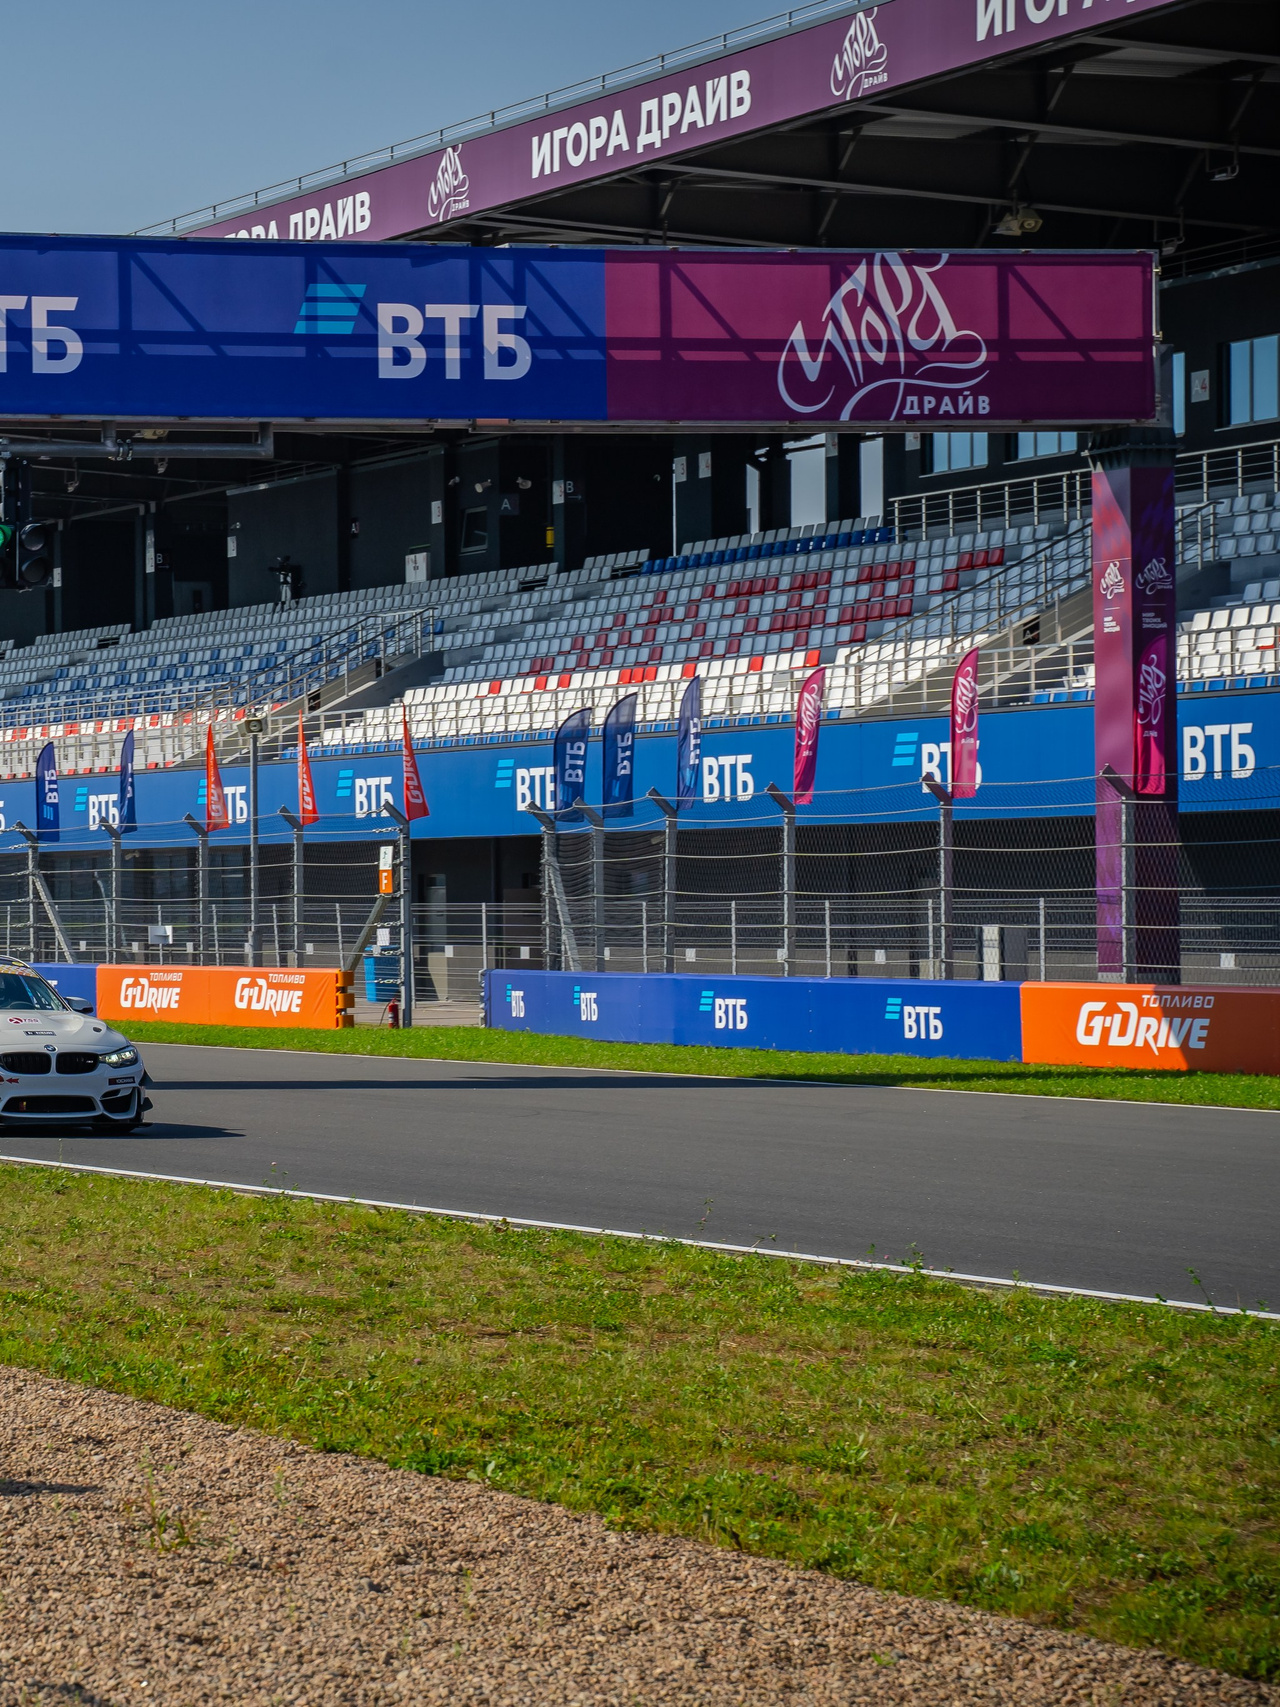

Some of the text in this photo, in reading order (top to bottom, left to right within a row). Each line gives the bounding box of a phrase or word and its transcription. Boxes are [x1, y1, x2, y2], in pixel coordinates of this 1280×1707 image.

[531, 69, 752, 179] ИГОРА ДРАЙВ
[376, 303, 533, 381] ВТБ
[903, 391, 991, 414] ДРАЙВ
[564, 741, 585, 783] ВТБ
[1183, 723, 1256, 781] ВТБ
[44, 769, 59, 803] ВТБ
[703, 754, 754, 803] ВТБ
[89, 794, 119, 831] ВТБ
[224, 786, 247, 824] ТБ
[355, 776, 394, 818] ВТБ
[149, 972, 183, 982] ТОПЛИВО
[268, 973, 306, 984] ТОПЛИВО
[511, 990, 525, 1018] ВТБ
[580, 992, 598, 1021] ВТБ
[714, 998, 748, 1030] ВТБ
[1141, 994, 1215, 1009] ТОПЛИВО
[903, 1006, 943, 1040] ВТБ
